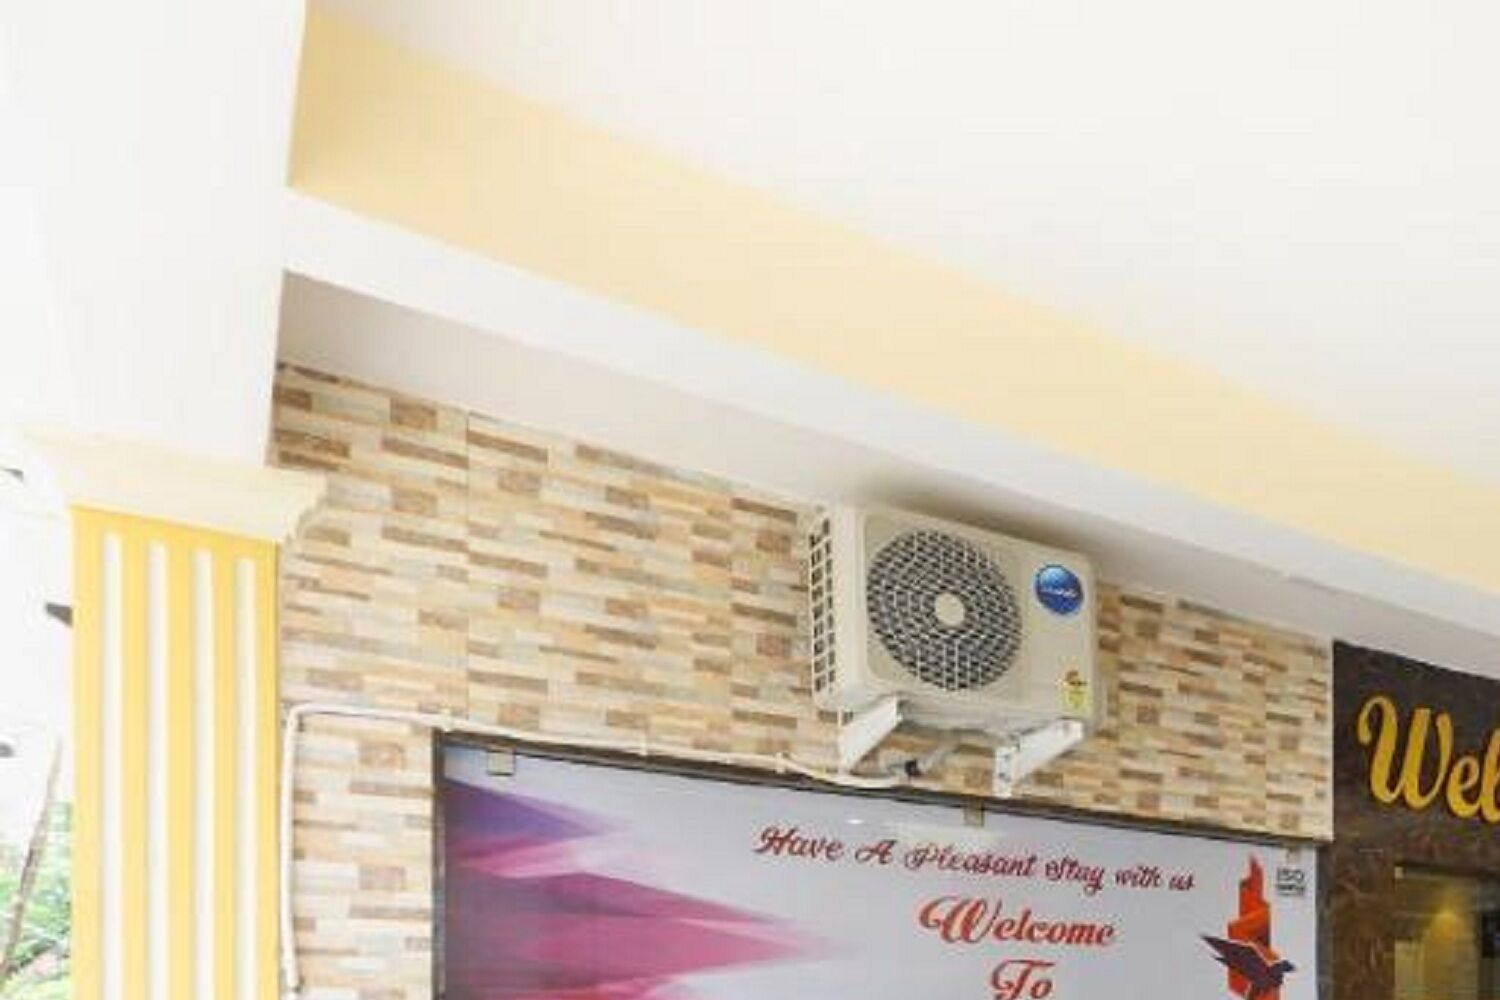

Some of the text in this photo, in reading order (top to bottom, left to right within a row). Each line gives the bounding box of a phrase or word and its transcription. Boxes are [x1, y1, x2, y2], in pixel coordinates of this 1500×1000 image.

[754, 825, 1195, 896] Have A Pleasant Stay with us
[919, 896, 1115, 946] Welcome
